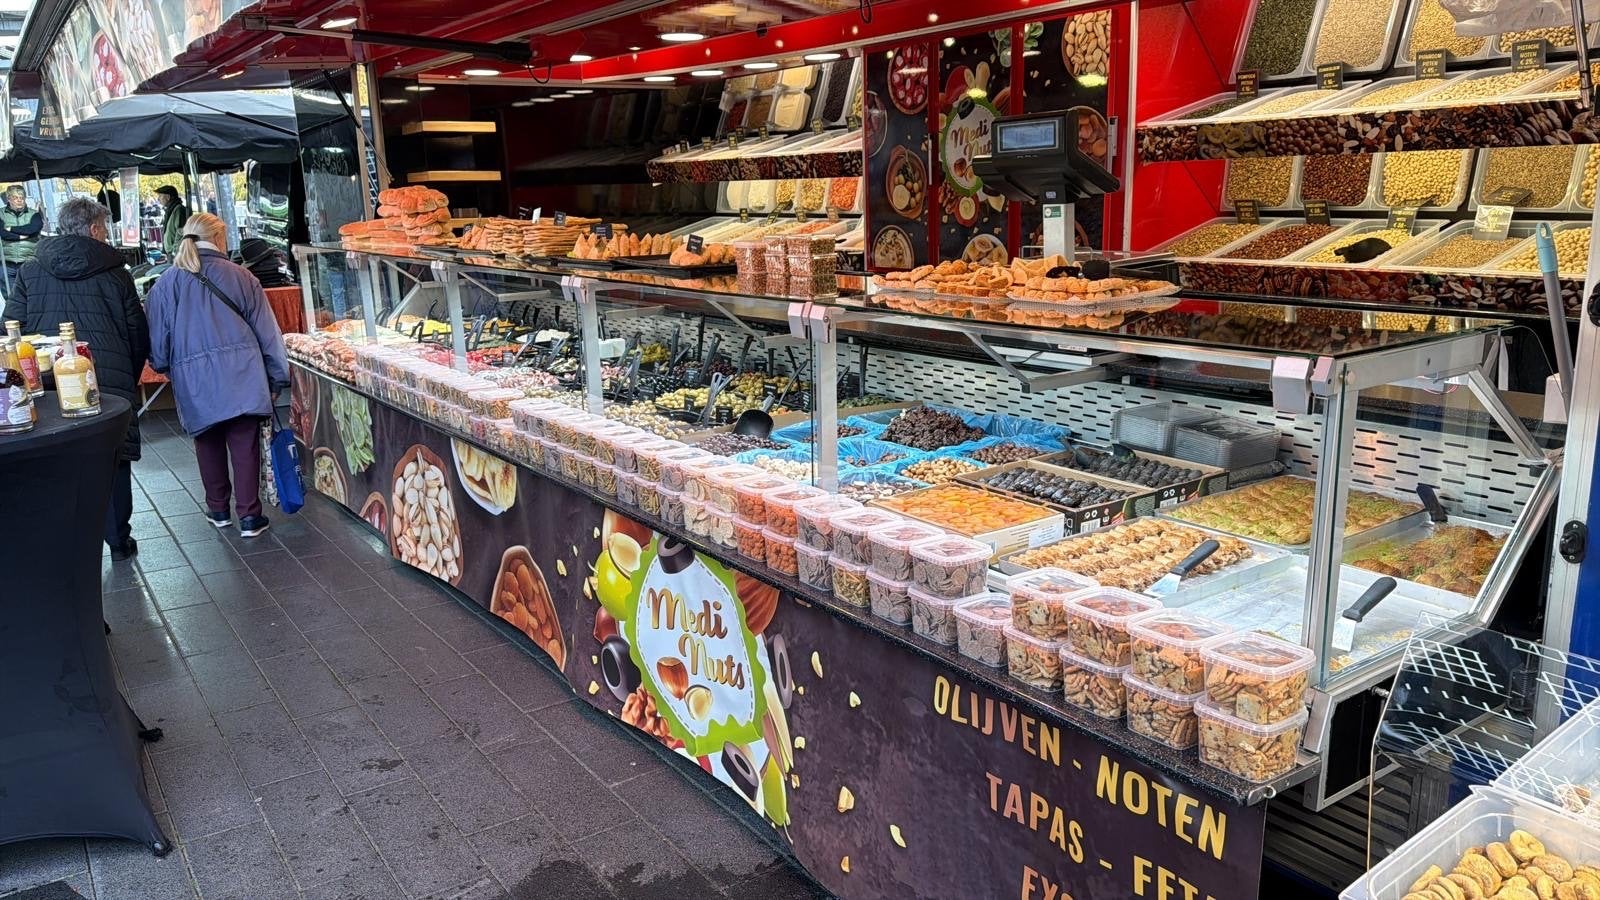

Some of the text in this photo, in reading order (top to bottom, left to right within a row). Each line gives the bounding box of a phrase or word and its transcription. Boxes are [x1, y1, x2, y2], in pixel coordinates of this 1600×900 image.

[951, 118, 989, 148] Medi
[963, 139, 992, 161] Nut
[646, 587, 728, 639] Medi
[678, 633, 745, 690] Nuts
[933, 675, 1061, 767] OLIJVEN
[1096, 754, 1227, 860] NOTEN
[985, 771, 1084, 864] TAPAS
[1133, 855, 1216, 900] FET
[1021, 864, 1074, 900] EX
